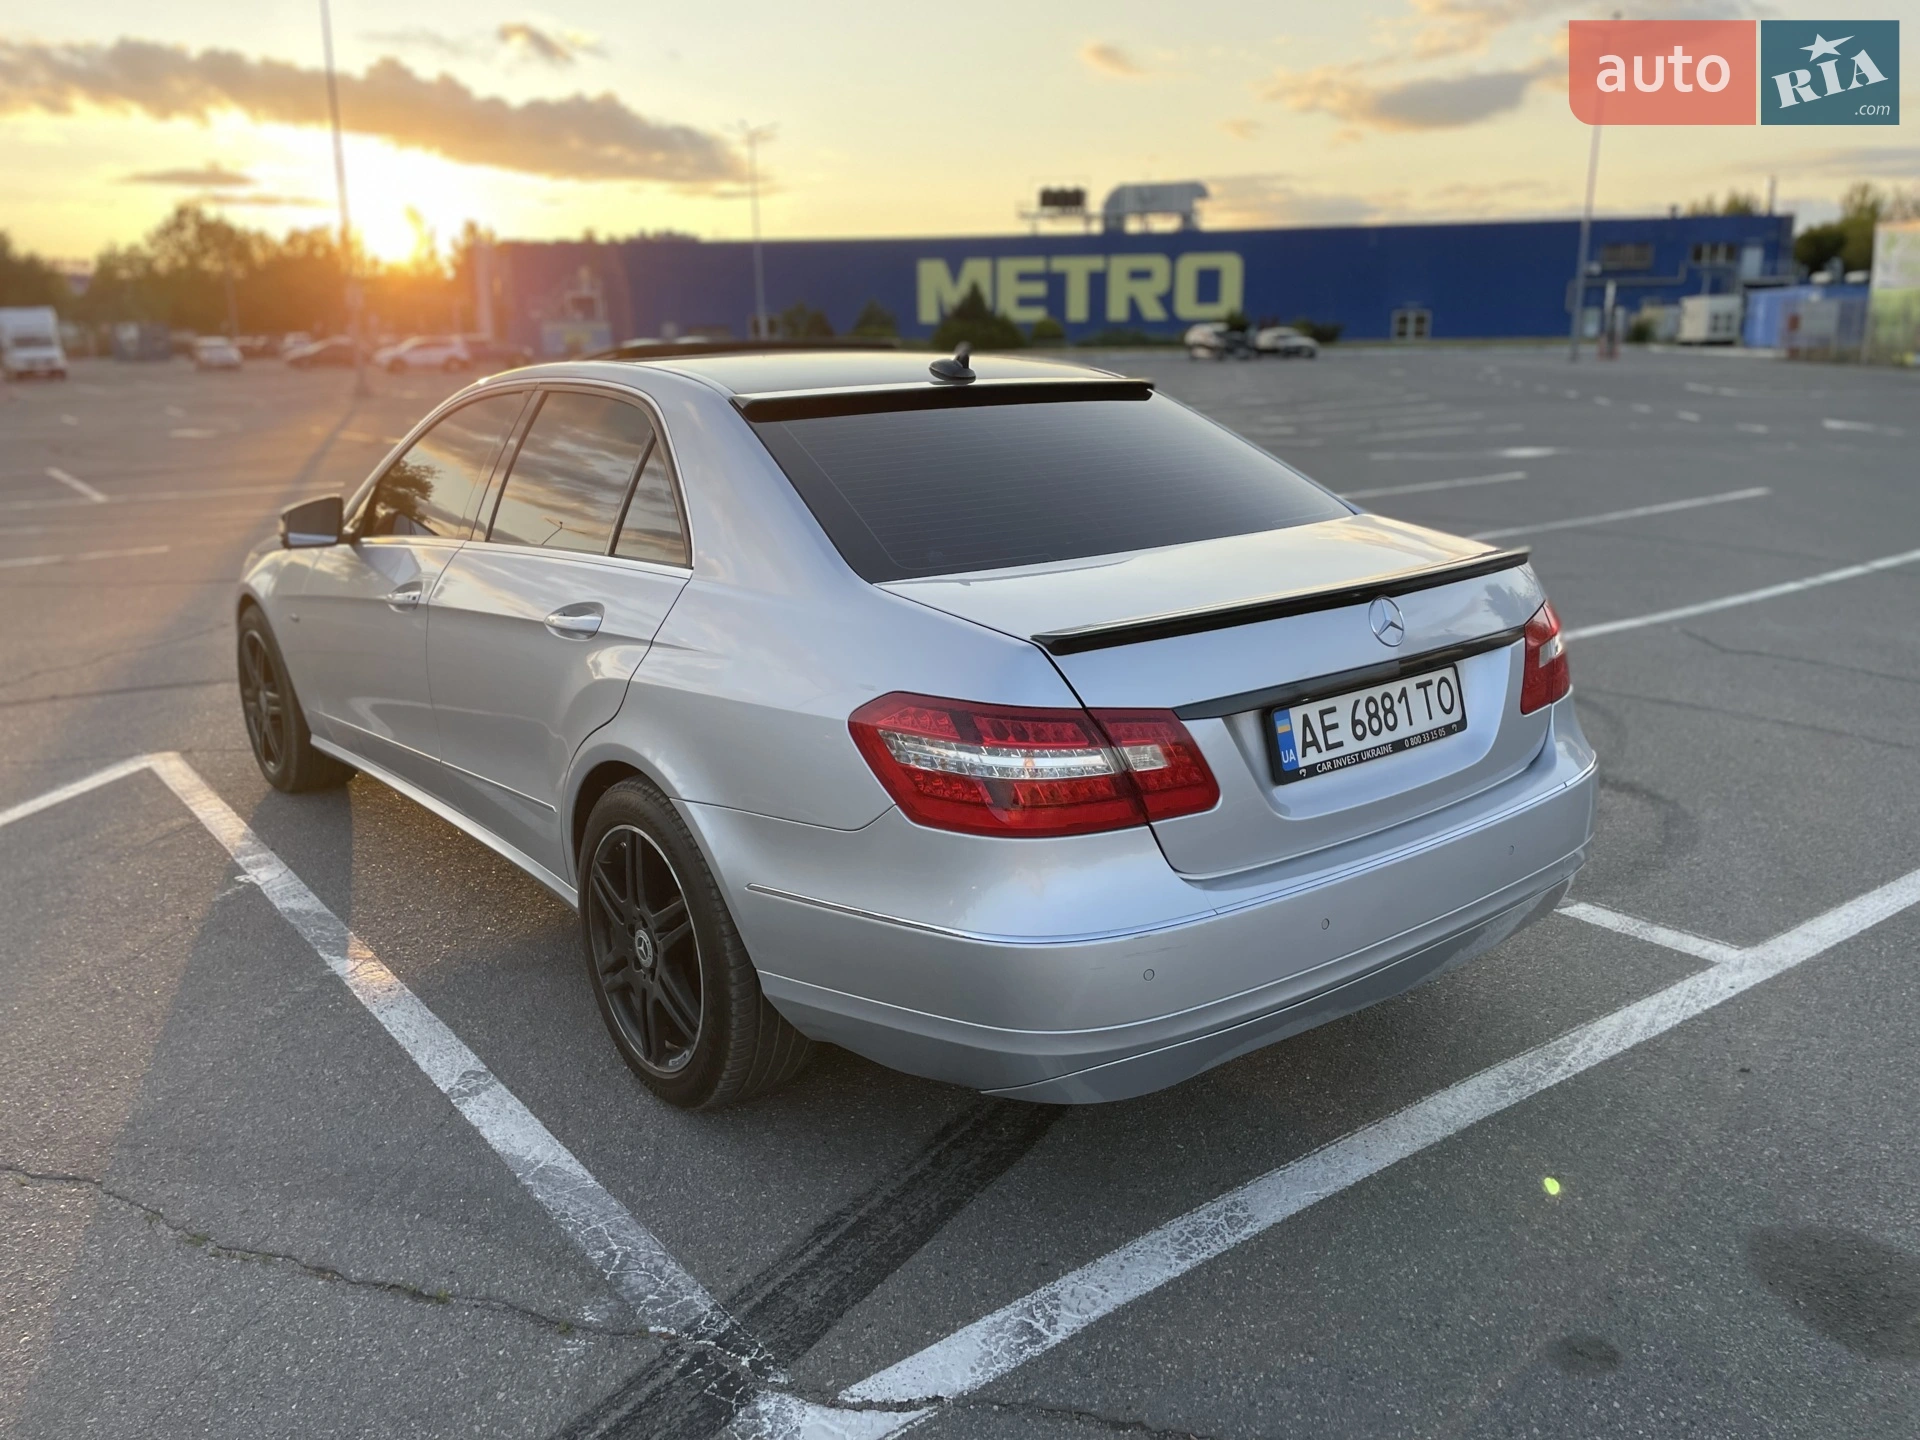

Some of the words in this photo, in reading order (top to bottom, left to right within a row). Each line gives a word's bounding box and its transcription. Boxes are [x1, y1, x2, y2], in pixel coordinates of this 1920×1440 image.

[916, 252, 1244, 325] METRO
[1301, 706, 1344, 759] AE
[1351, 686, 1414, 742] 6881
[1415, 676, 1455, 720] TO
[1281, 748, 1296, 764] UA
[1404, 738, 1410, 748] 0
[1409, 735, 1422, 746] 800
[1316, 760, 1333, 773] CAR
[1333, 753, 1360, 769] INVEST
[1360, 743, 1393, 761] UKRAINE
